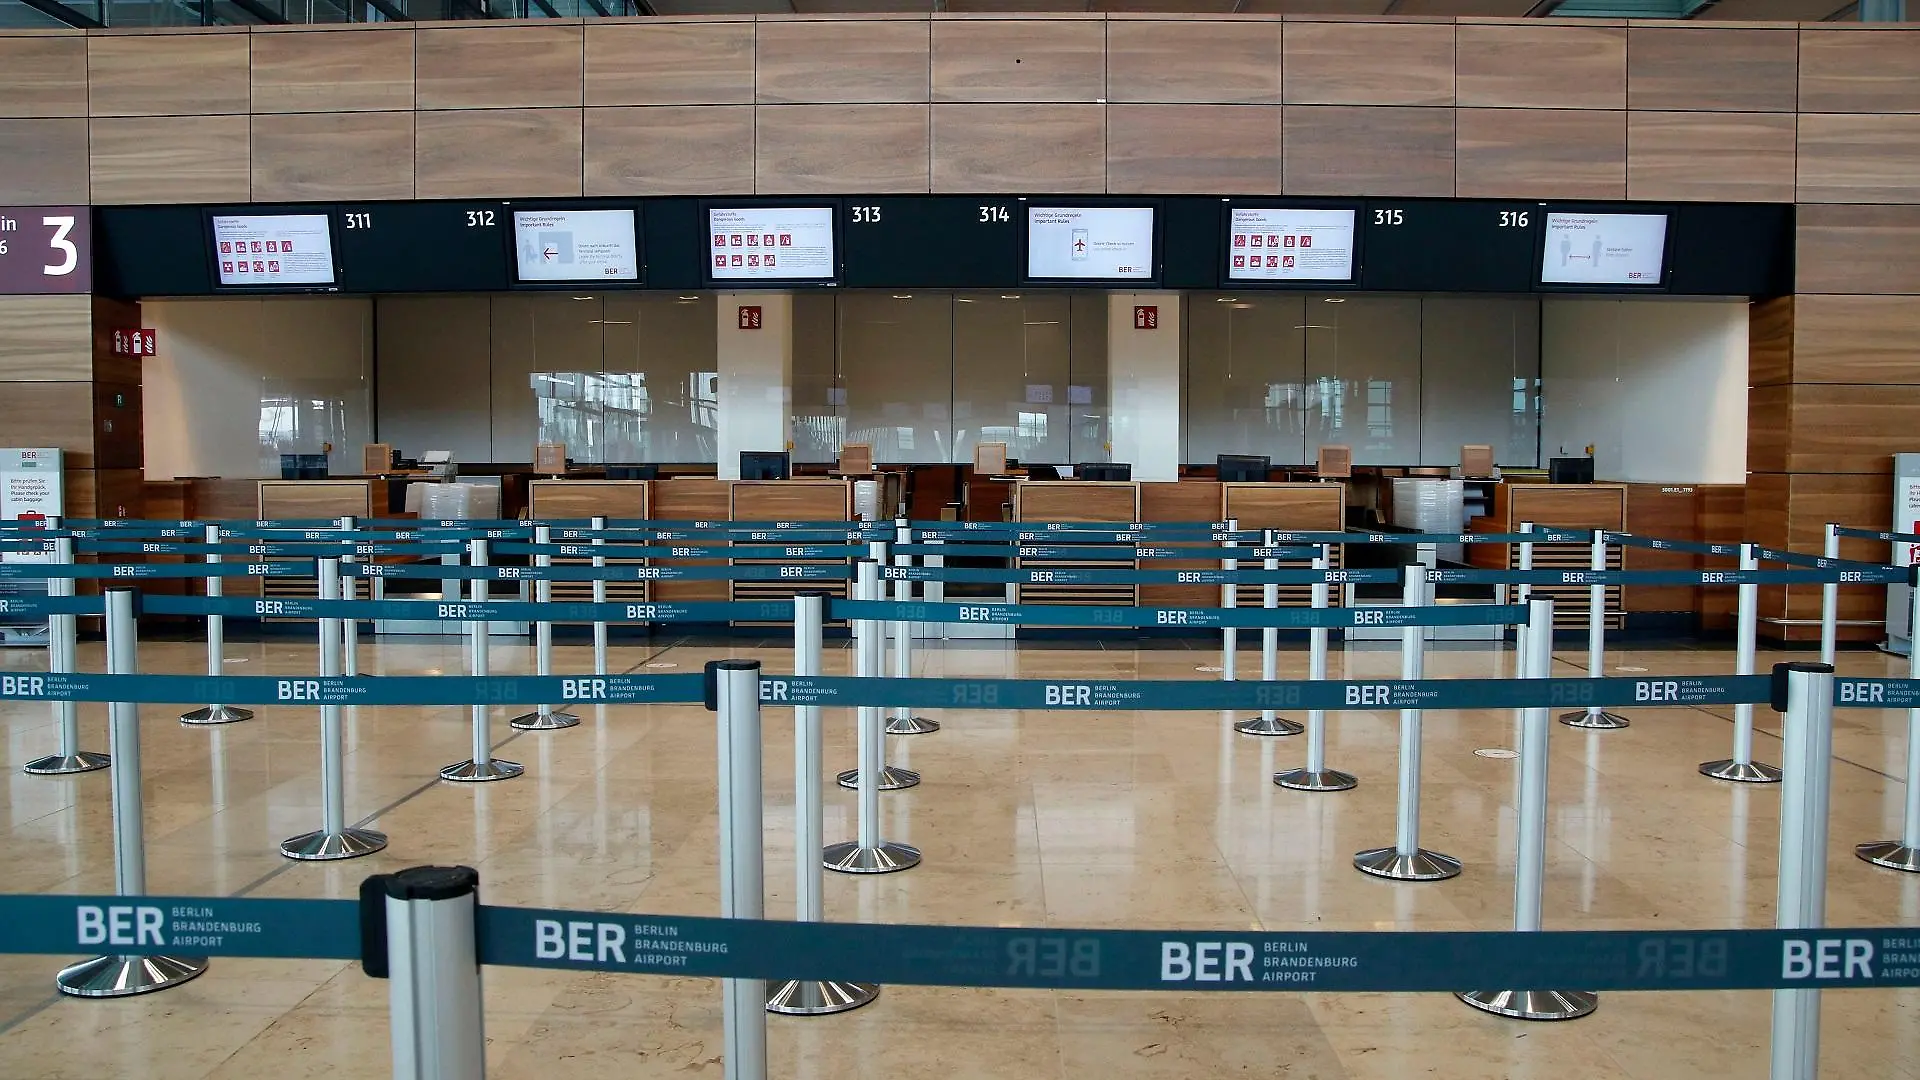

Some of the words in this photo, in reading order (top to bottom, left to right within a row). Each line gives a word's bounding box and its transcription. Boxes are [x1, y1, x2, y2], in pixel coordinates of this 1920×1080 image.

[466, 210, 495, 226] 312
[852, 207, 881, 222] 313
[980, 206, 1009, 222] 314
[1374, 210, 1403, 224] 315
[1499, 212, 1528, 227] 316
[346, 213, 371, 229] 311
[43, 216, 77, 275] 3
[672, 548, 689, 556] BER
[786, 548, 804, 556] BER
[1020, 548, 1037, 556] BER
[114, 566, 134, 576] BER
[248, 565, 269, 574] BER
[362, 565, 383, 575] BER
[499, 568, 519, 578] BER
[638, 568, 659, 578] BER
[781, 567, 802, 576] BER
[885, 568, 907, 578] BER
[1031, 572, 1053, 581] BER
[1178, 572, 1200, 582] BER
[1325, 572, 1347, 581] BER
[1426, 571, 1442, 581] ER
[1563, 572, 1584, 582] BER
[1702, 572, 1723, 582] BER
[1840, 572, 1861, 581] BER
[256, 600, 282, 614] BER
[438, 605, 466, 618] BER
[627, 606, 656, 618] BER
[960, 607, 989, 620] BER
[1158, 611, 1187, 624] BER
[1354, 611, 1383, 624] BER
[3, 676, 44, 695] BER
[278, 680, 320, 700] BER
[562, 679, 606, 698] BER
[759, 680, 787, 700] ER
[1636, 681, 1678, 700] BER
[1046, 686, 1090, 705] BER
[1346, 686, 1389, 705] BER
[1840, 683, 1883, 702] BER
[172, 907, 213, 917] BERLIN
[77, 906, 165, 945] BER
[172, 922, 261, 932] BRANDENBURG
[634, 924, 678, 936] BERLIN
[172, 936, 223, 946] AIRPORT
[536, 919, 626, 963] BER
[634, 940, 729, 953] BRANDENBURG
[1264, 942, 1308, 952] BERLIN
[1883, 939, 1920, 949] BERLI
[634, 955, 687, 966] AIRPORT
[1162, 941, 1255, 981] BER
[1264, 957, 1357, 967] BRANDENBURG
[1782, 939, 1873, 979] BER
[1263, 971, 1316, 981] AIRPORT
